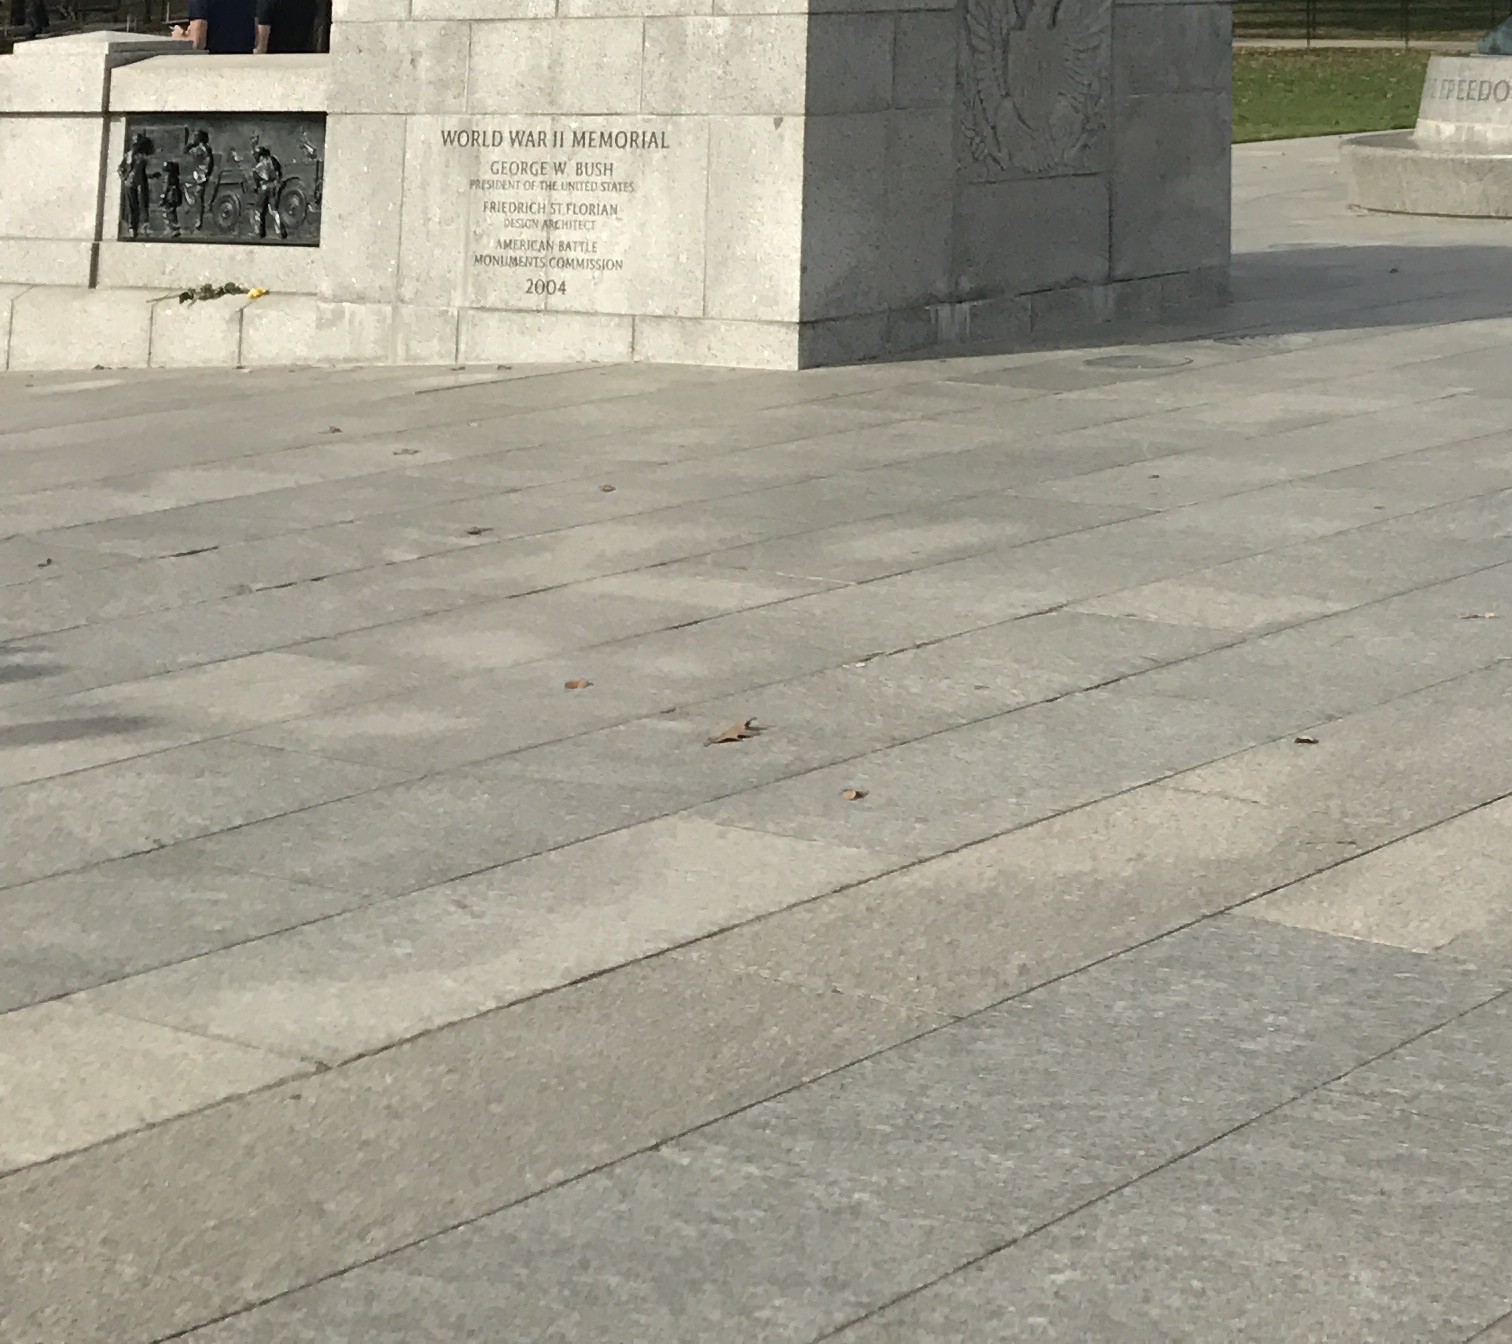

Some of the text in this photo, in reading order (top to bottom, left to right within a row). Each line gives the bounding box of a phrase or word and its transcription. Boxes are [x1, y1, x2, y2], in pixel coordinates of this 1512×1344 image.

[441, 129, 670, 150] WORLD WAR II MEMORIAL
[490, 160, 548, 176] GEORGE
[575, 161, 615, 177] BUSH
[469, 178, 635, 193] PRESIDENT OF THE UNITED STATES
[482, 200, 546, 214] FRIEDRICH
[566, 202, 619, 216] FLORIAN
[503, 217, 597, 231] DESIGN ARCHITECT
[495, 238, 598, 253] AMERICAN BATTLE
[473, 254, 623, 271] MONUMENTS COMMISSION
[526, 277, 567, 296] 2004
